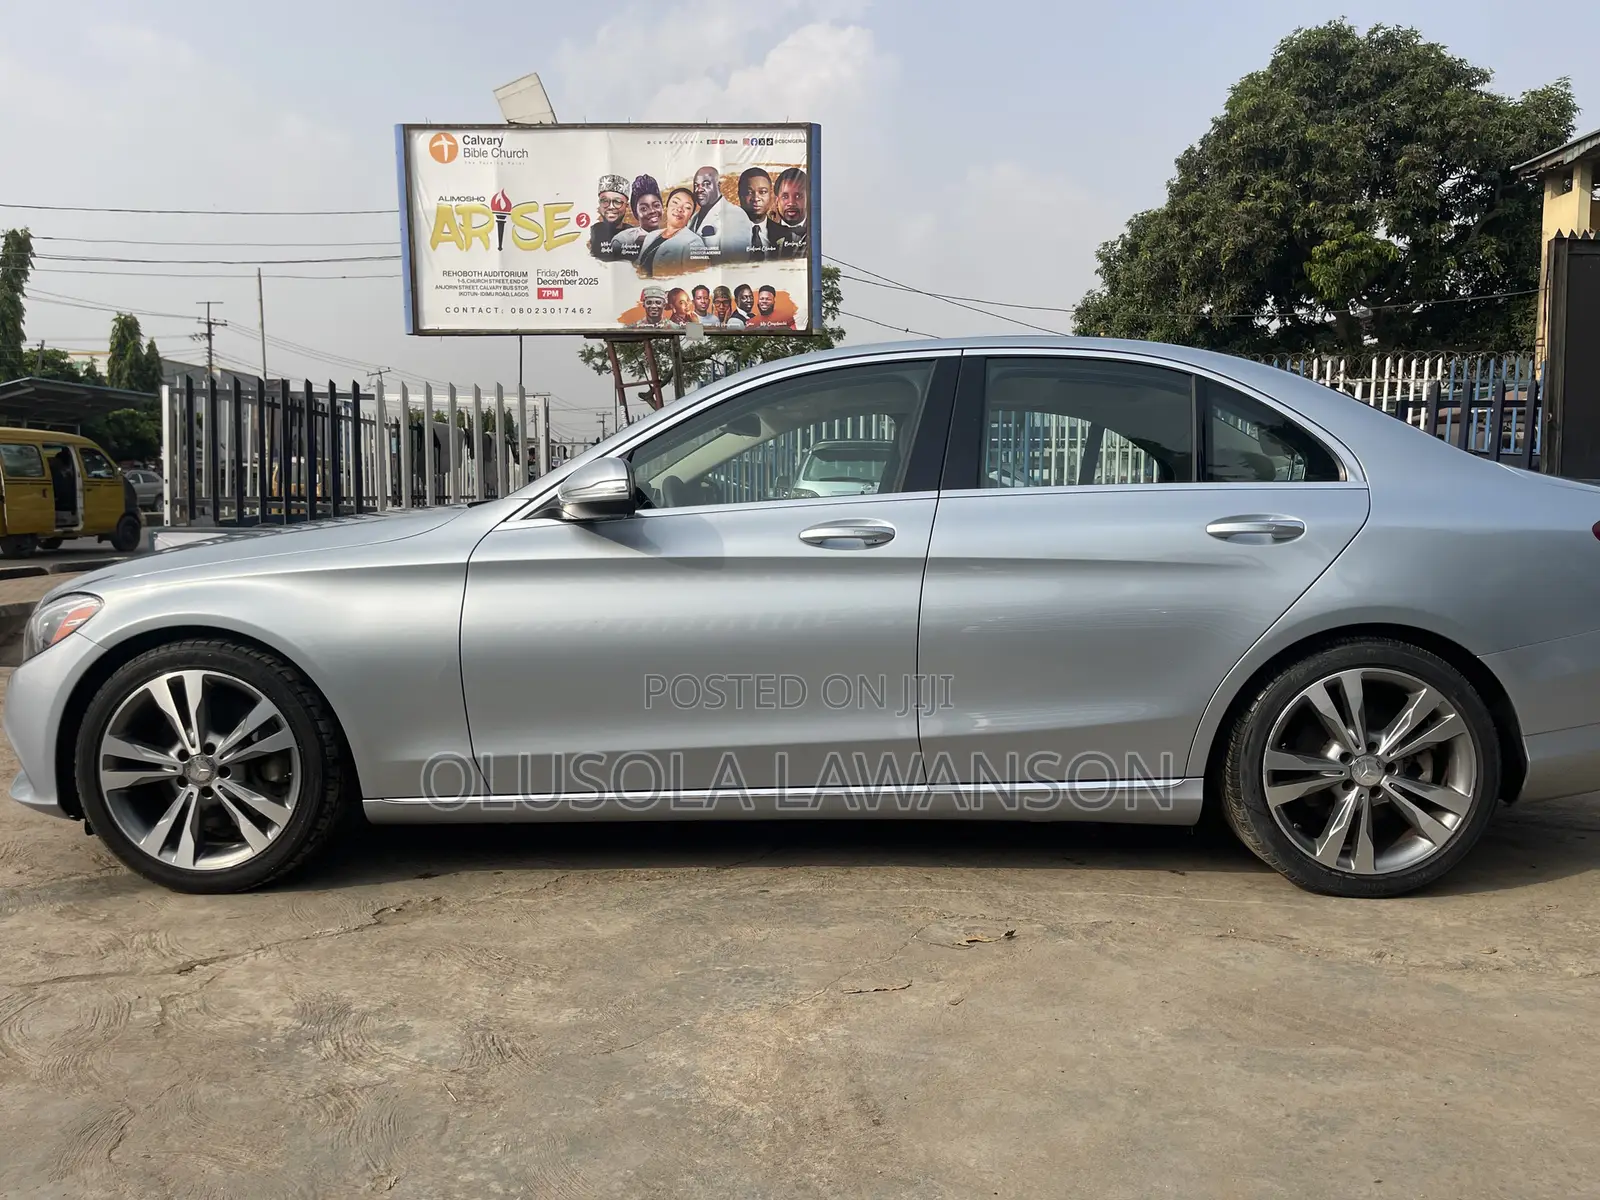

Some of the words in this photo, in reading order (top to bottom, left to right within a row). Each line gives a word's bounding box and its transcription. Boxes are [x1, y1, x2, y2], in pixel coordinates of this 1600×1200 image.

[462, 134, 504, 148] Calvary
[463, 147, 488, 158] Bible
[491, 147, 529, 159] Church
[438, 195, 486, 203] ALIMOSHO
[430, 188, 582, 252] ARISE
[483, 270, 529, 278] AUDITORIUM
[536, 269, 560, 278] Friday
[560, 269, 579, 277] 26th
[536, 277, 577, 286] December
[578, 277, 599, 286] 2025
[541, 289, 559, 298] 7PM
[445, 306, 505, 315] CONTACT:
[510, 307, 592, 315] 08023017462
